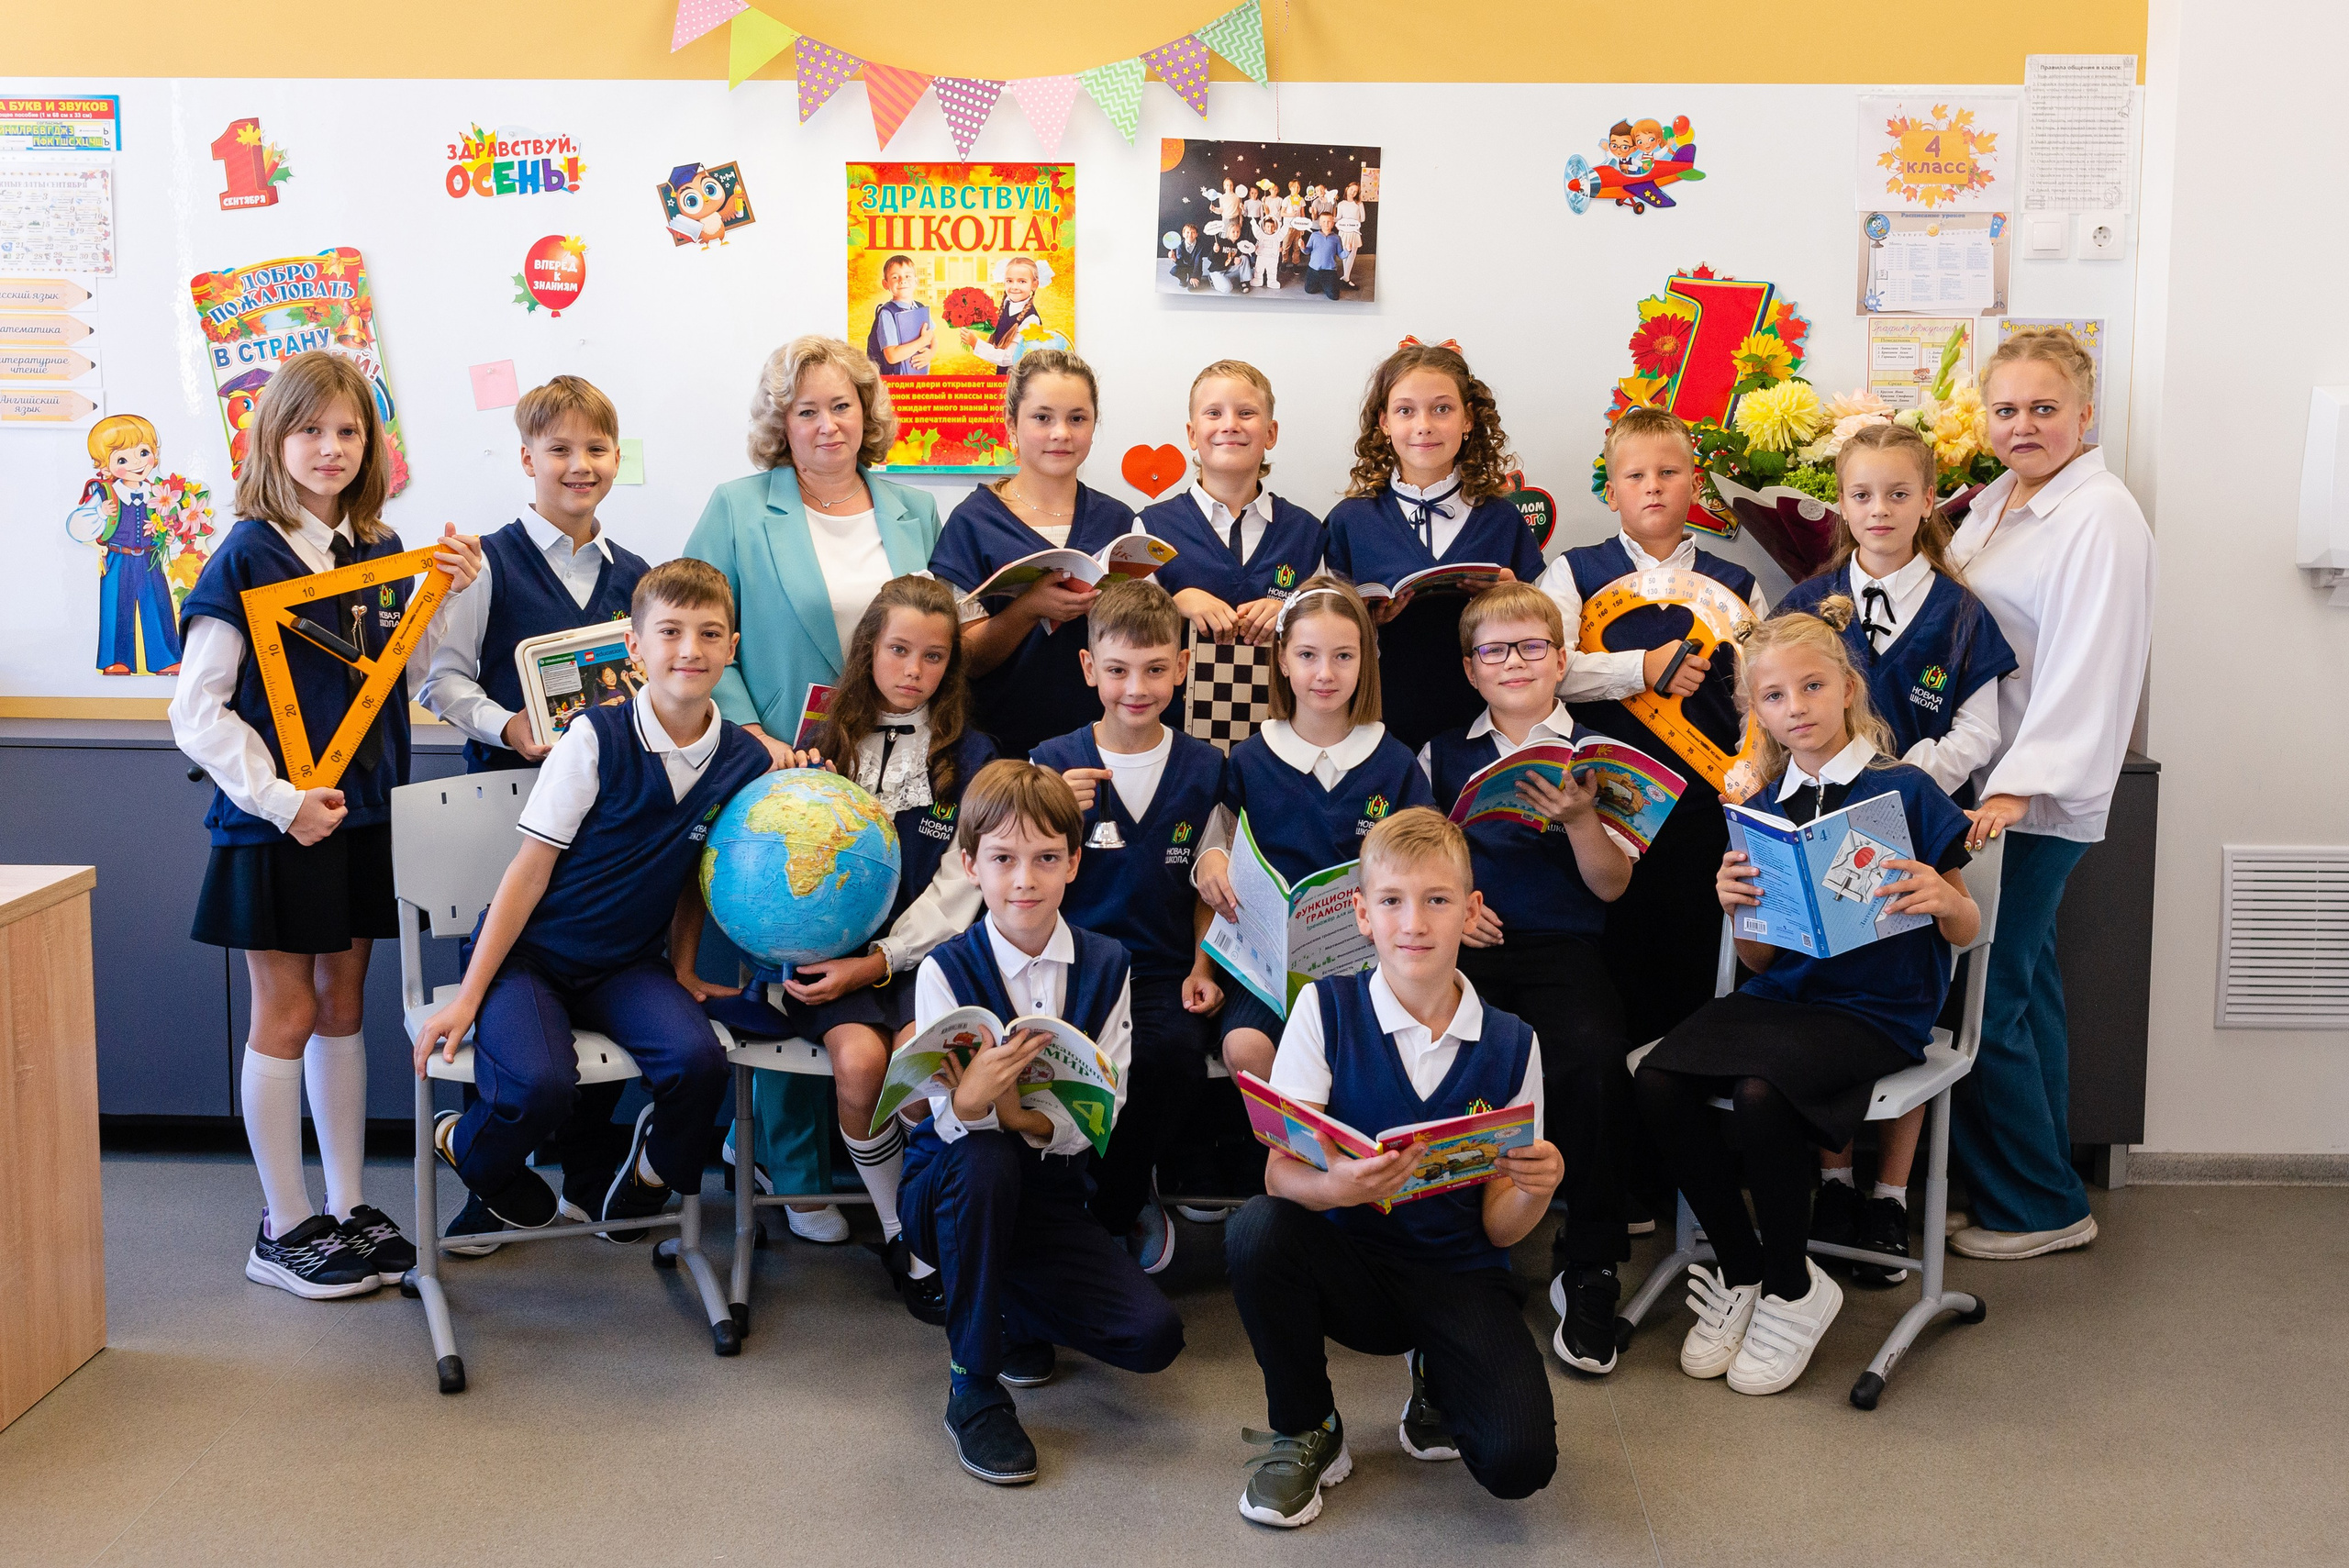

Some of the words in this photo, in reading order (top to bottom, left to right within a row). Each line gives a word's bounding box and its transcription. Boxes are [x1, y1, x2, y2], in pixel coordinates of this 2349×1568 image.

[9, 101, 42, 111] БУКВ
[45, 101, 55, 111] И
[58, 101, 108, 112] ЗВУКОВ
[446, 133, 577, 161] ЗДРАВСТВУЙ,
[1924, 135, 1941, 158] 4
[1907, 161, 1966, 174] класс
[445, 157, 580, 198] ОСЕНЬ!
[223, 195, 266, 206] СЕНТЯБРЯ
[862, 180, 1061, 213] ЗДРАВСТВУЙ,
[863, 215, 1060, 252] ШКОЛА!
[241, 262, 317, 293] ДОБРО
[554, 271, 562, 282] К
[533, 280, 579, 293] ЗНАНИЯМ
[32, 291, 60, 303] язык
[206, 281, 355, 326] ПОЖАЛОВАТЬ
[214, 347, 229, 369] В
[238, 327, 330, 361] СТРАНУ
[10, 366, 49, 374] чтение
[882, 381, 915, 389] Сегодня
[916, 382, 941, 390] двери
[941, 382, 985, 390] открывает
[0, 395, 61, 405] Английский
[912, 392, 947, 400] веселый
[15, 404, 42, 417] язык
[915, 416, 967, 424] впечатлений
[968, 416, 995, 425] целый
[302, 585, 316, 598] 10
[362, 572, 375, 584] 20
[420, 557, 434, 569] 30
[423, 591, 435, 603] 10
[1595, 600, 1602, 609] 20
[1611, 589, 1619, 597] 30
[1705, 587, 1713, 595] 80
[1717, 601, 1728, 613] 90
[1585, 621, 1595, 632] 170
[1598, 608, 1609, 618] 160
[1612, 598, 1623, 607] 150
[1629, 592, 1640, 600] 140
[1682, 590, 1693, 598] 110
[1700, 597, 1710, 606] 100
[268, 643, 281, 657] 10
[393, 641, 406, 655] 20
[596, 648, 623, 657] education
[362, 695, 374, 709] 30
[1912, 685, 1943, 706] НОВАЯ
[284, 704, 296, 717] 20
[1909, 694, 1940, 713] ШКОЛА
[330, 749, 343, 762] 40
[1667, 729, 1675, 738] 30
[1727, 782, 1733, 790] 45
[300, 764, 313, 777] 30
[1744, 761, 1752, 769] 10
[1740, 784, 1750, 796] 180
[920, 817, 954, 833] НОВАЯ
[1357, 819, 1375, 829] НОВ
[1547, 824, 1566, 834] ШКО
[918, 825, 951, 841] ШКОЛА
[1820, 828, 1828, 842] 4
[1166, 847, 1190, 857] НОВАЯ
[1165, 855, 1188, 864] ШКОЛА
[1295, 885, 1361, 920] ФУНКЦИОНА
[1306, 898, 1353, 925] ГРАМОТН
[1322, 924, 1353, 939] грамотность
[1324, 933, 1364, 951] Математическ
[1043, 1047, 1090, 1077] МИР
[1072, 1100, 1106, 1137] 4
